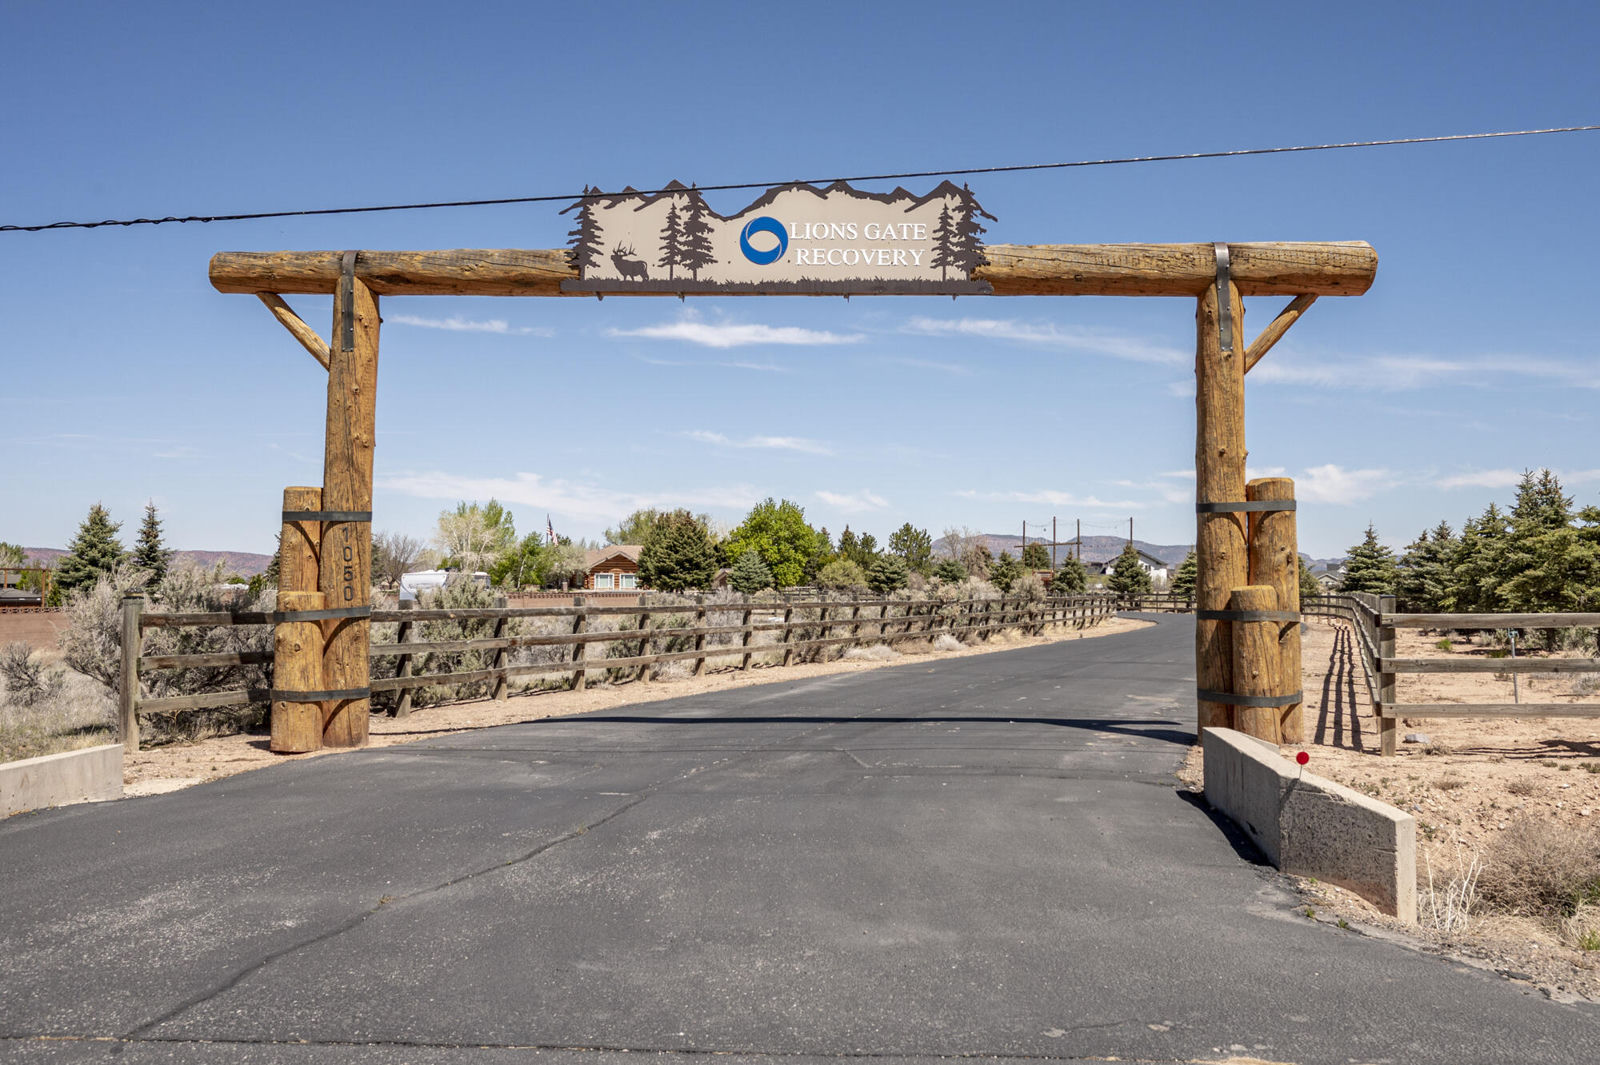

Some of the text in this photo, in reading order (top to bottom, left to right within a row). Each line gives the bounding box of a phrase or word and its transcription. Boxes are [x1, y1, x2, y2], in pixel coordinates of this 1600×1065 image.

[789, 222, 928, 241] LIONS GATE
[795, 248, 925, 266] RECOVERY
[342, 527, 353, 601] 1050
